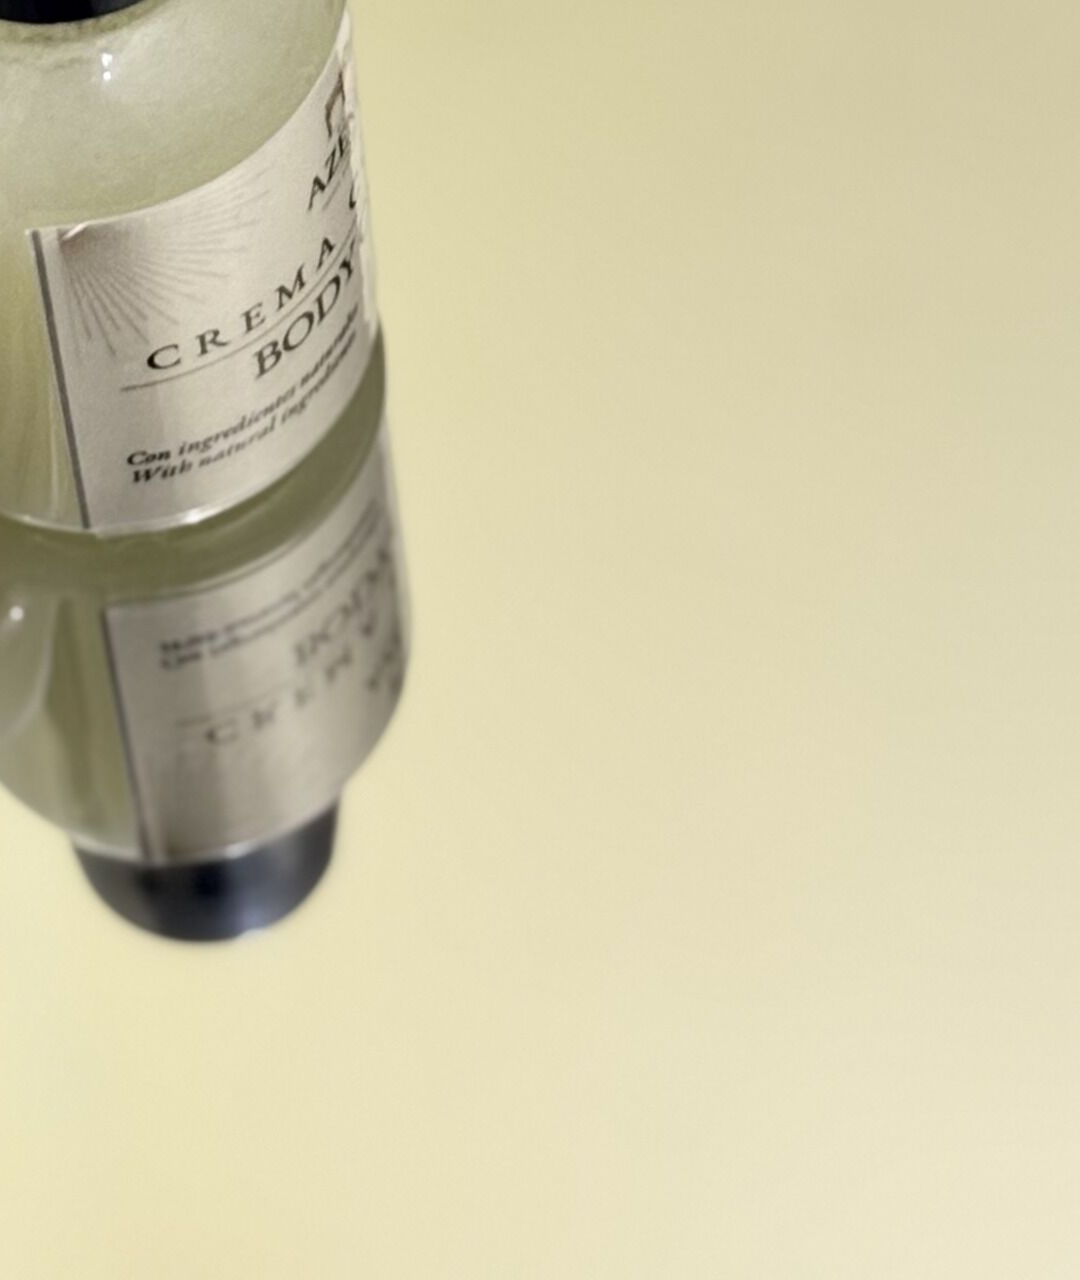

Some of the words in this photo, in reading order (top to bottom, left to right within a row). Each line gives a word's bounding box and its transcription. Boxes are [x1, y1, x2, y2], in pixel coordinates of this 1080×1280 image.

[146, 236, 336, 371] CREMA
[252, 237, 356, 381] BODY
[126, 446, 172, 467] Con
[131, 456, 194, 485] With
